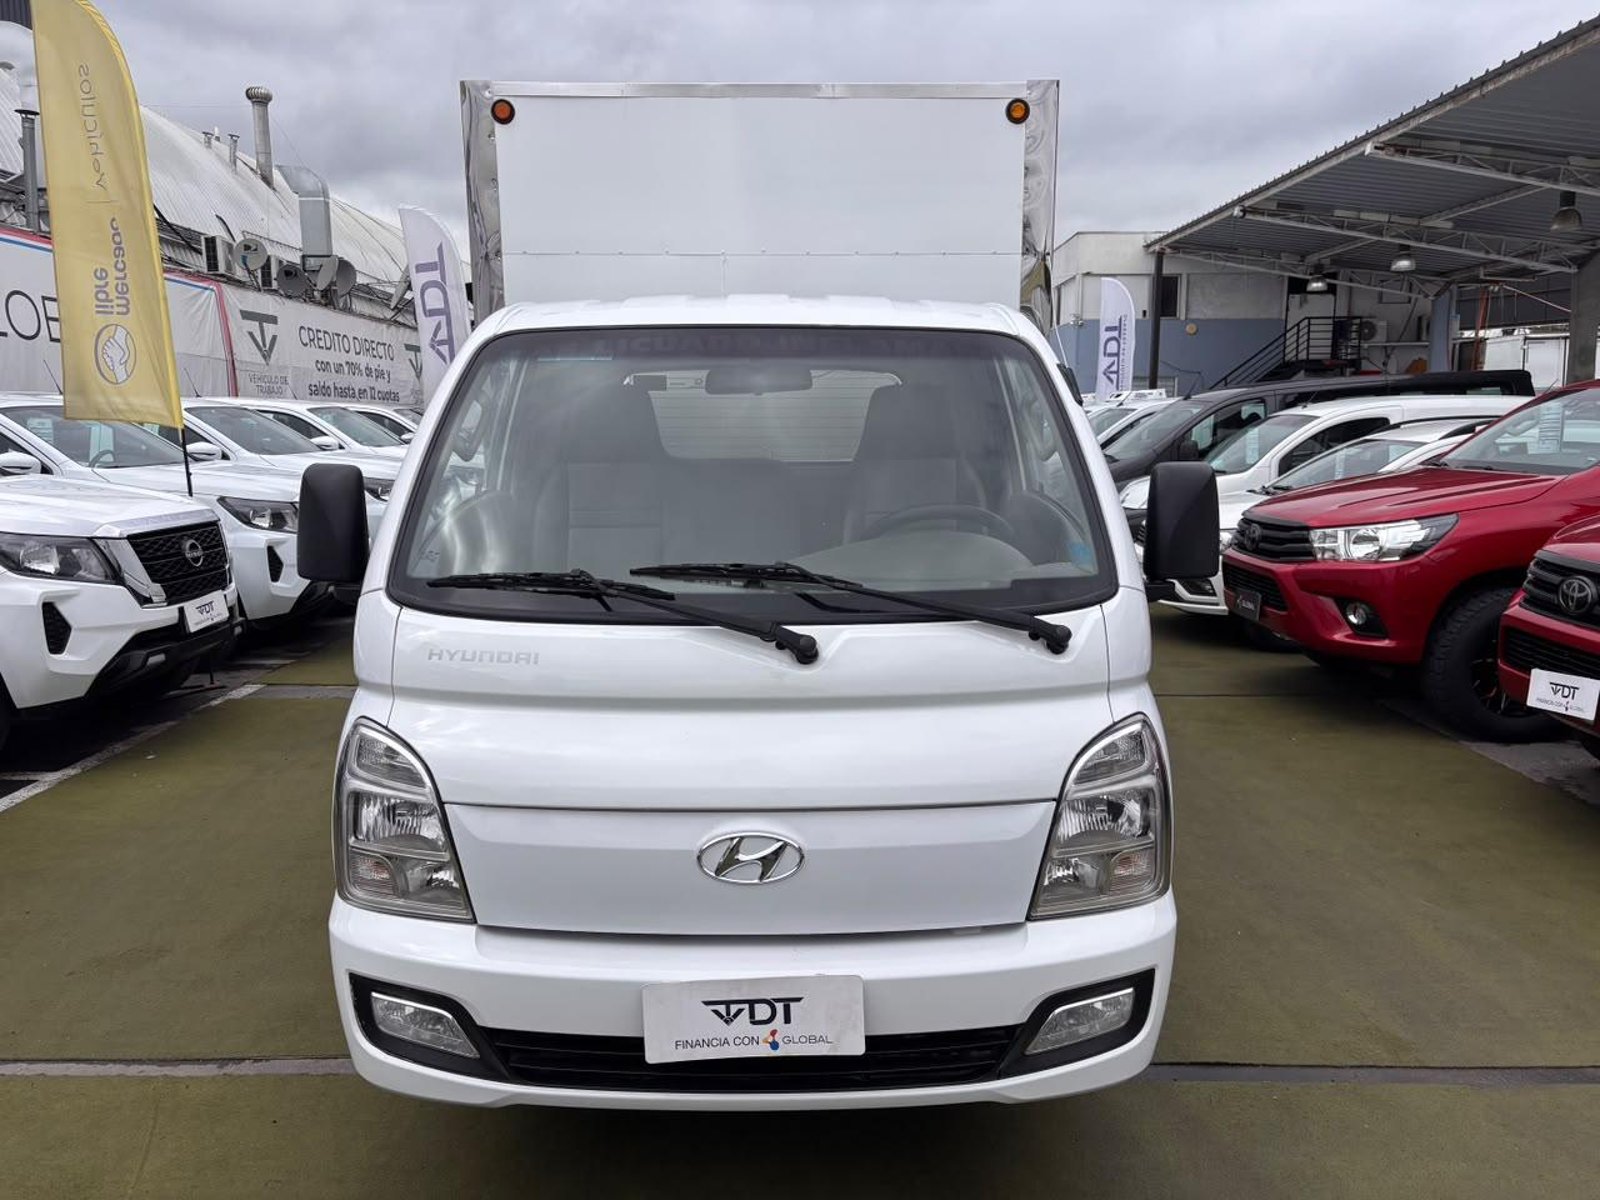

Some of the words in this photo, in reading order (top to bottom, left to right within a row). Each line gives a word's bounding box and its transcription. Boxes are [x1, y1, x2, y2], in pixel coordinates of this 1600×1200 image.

[298, 325, 351, 354] CREDITO
[352, 336, 395, 361] DIRECTO
[315, 359, 332, 373] con
[333, 362, 345, 375] un
[345, 361, 364, 377] 70%
[364, 362, 374, 378] de
[308, 380, 332, 397] saldo
[333, 381, 357, 399] hasta
[358, 387, 369, 400] en
[427, 648, 540, 665] HYUNDAI
[701, 997, 804, 1026] VDT
[674, 1033, 731, 1050] FINANCIA
[733, 1035, 760, 1046] CON
[782, 1034, 833, 1046] GLOBAL
